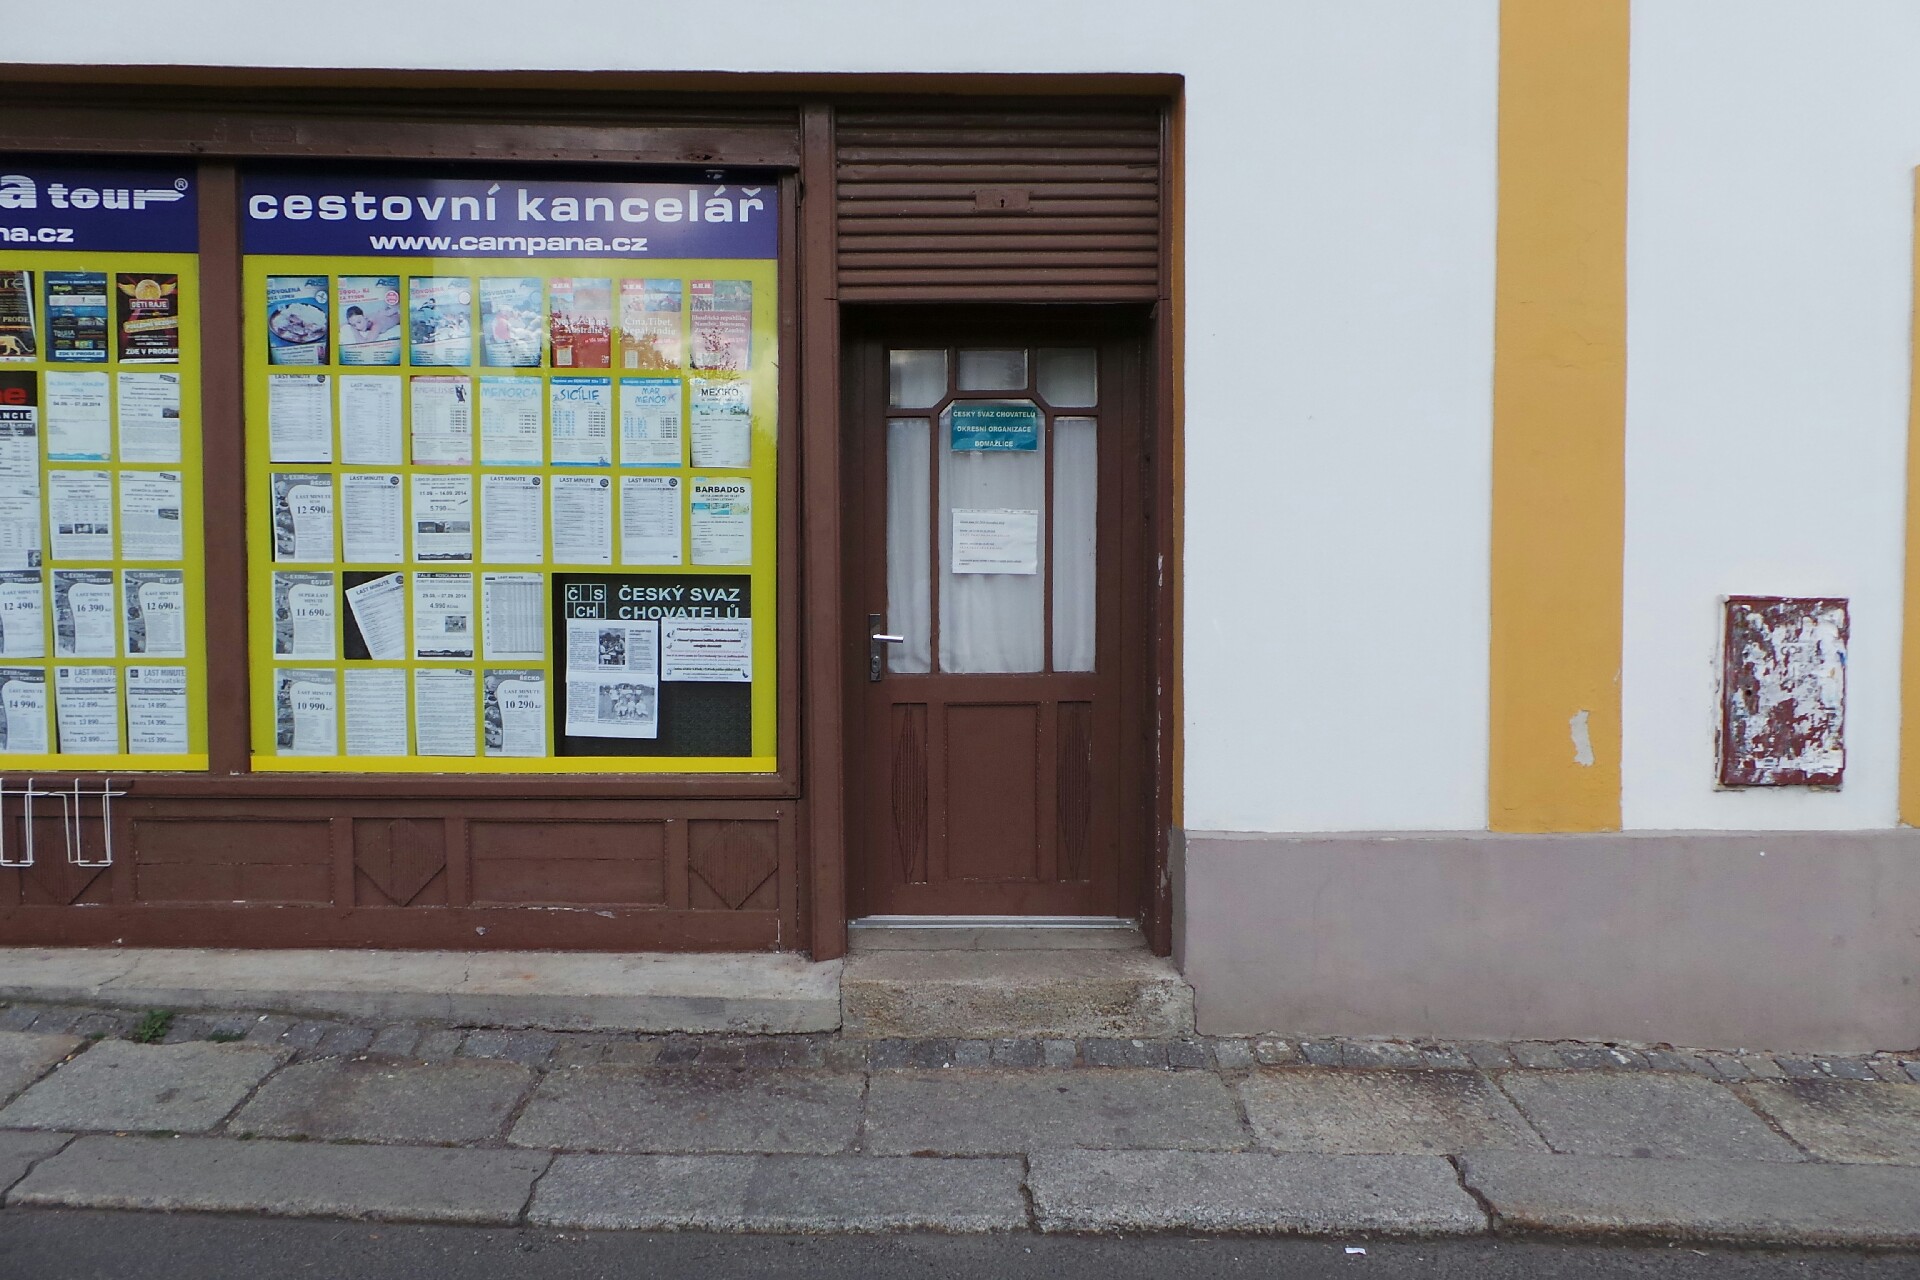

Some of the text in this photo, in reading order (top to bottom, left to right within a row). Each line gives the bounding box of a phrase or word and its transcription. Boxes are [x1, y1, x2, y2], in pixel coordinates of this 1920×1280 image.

[249, 184, 764, 223] cestovní kancelář
[369, 234, 648, 256] www.campana.cz
[481, 387, 538, 398] MENORCA
[641, 387, 660, 395] MAR
[297, 505, 326, 514] 12 590
[356, 585, 369, 595] LAST
[567, 586, 604, 600] Č S
[618, 584, 740, 602] ČESKÝ SVAZ
[4, 602, 34, 610] 12 490
[77, 604, 86, 612] 16
[147, 602, 174, 610] 12 690
[296, 608, 325, 616] 11 690
[576, 606, 596, 618] CH
[618, 604, 739, 620] CHOVATELŮ
[9, 700, 36, 708] 14 990
[297, 702, 325, 710] 10 990
[505, 700, 534, 708] 10 290
